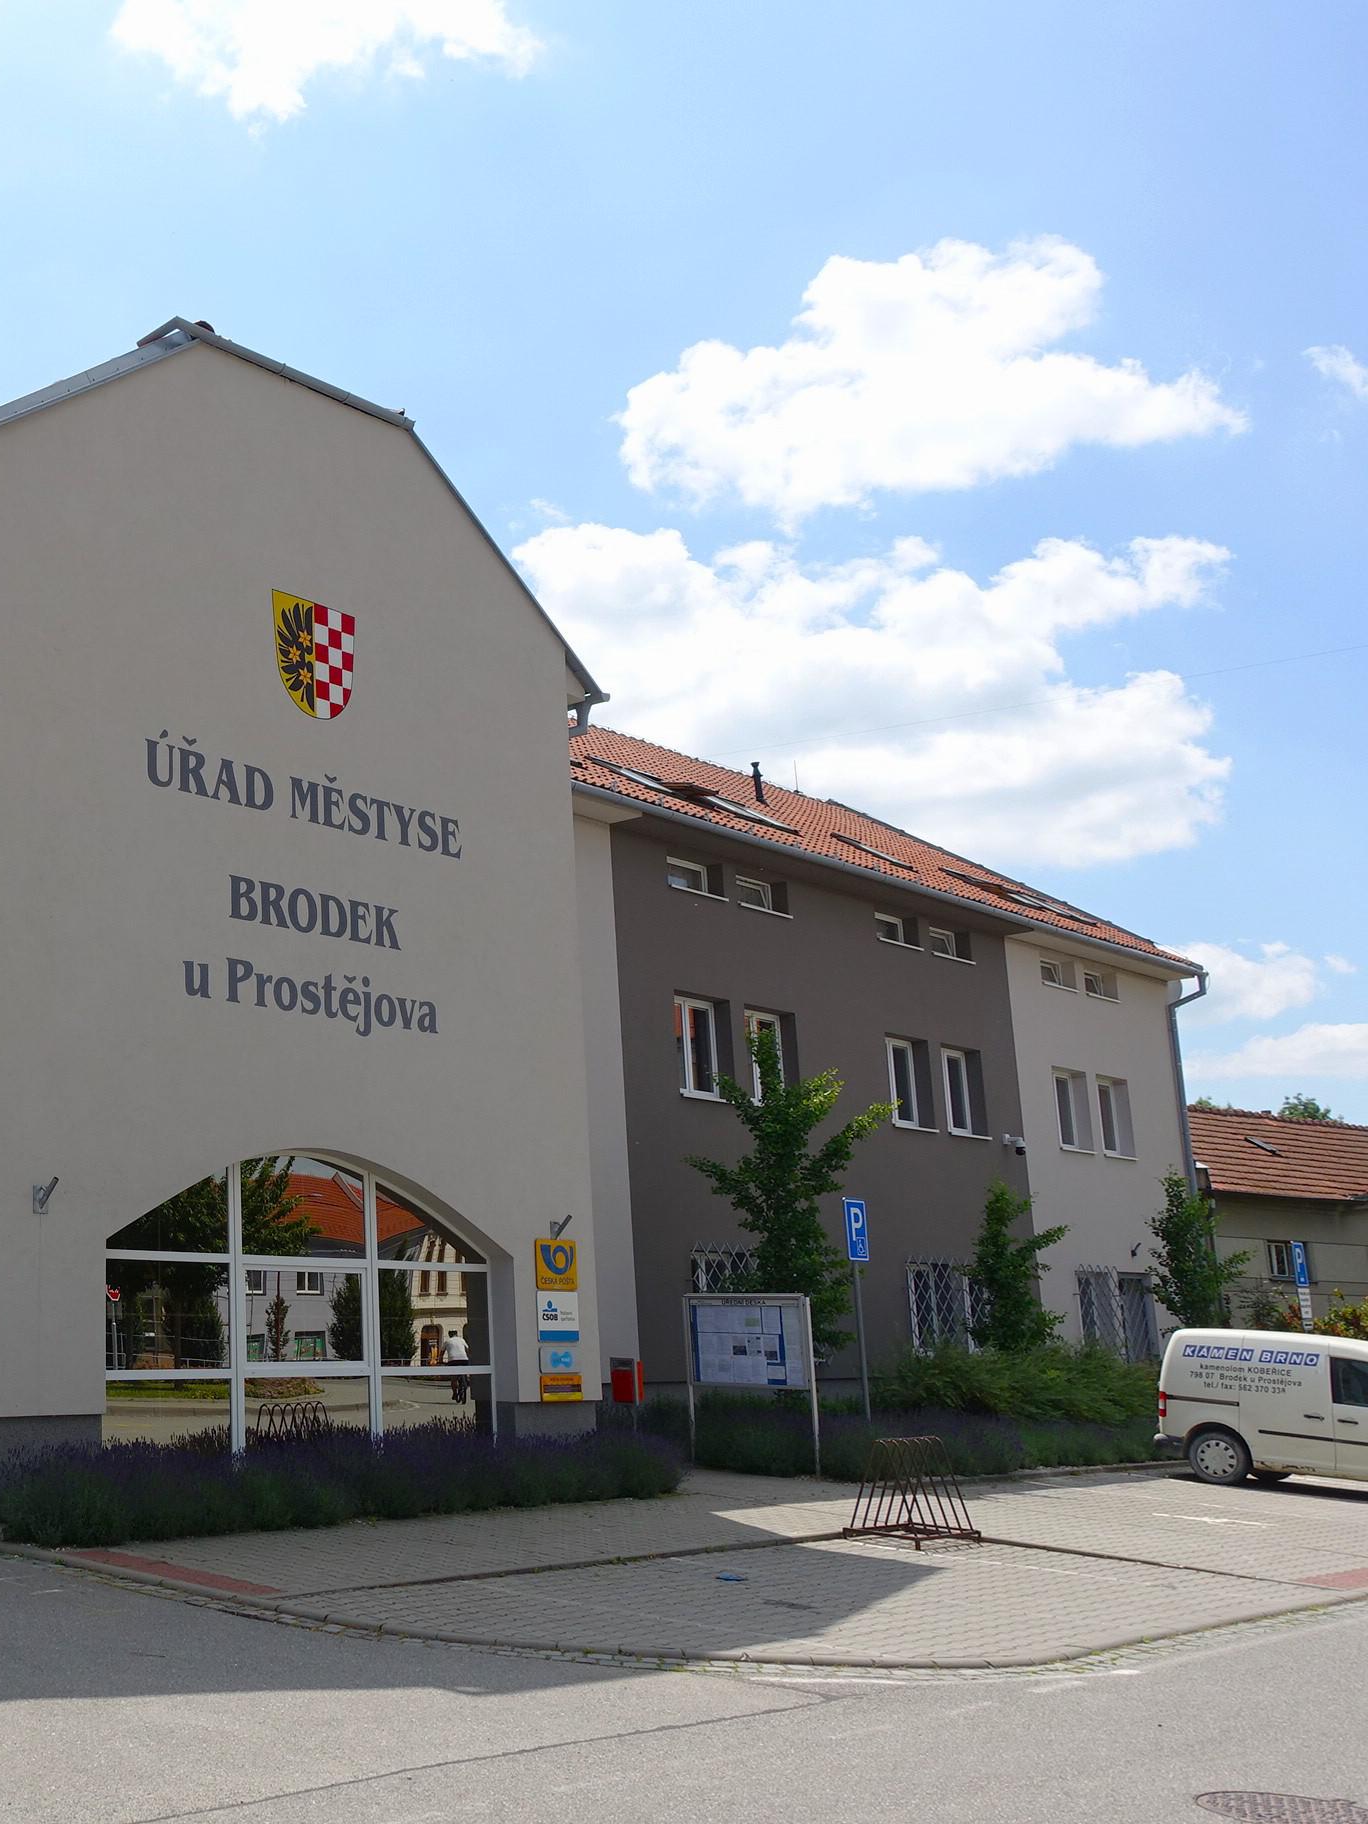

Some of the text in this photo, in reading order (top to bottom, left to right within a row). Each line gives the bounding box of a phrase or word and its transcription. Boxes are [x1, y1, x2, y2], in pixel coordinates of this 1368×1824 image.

[145, 729, 462, 859] ÚŘAD MĚSTYSE
[229, 874, 402, 951] BRODEK
[183, 957, 439, 1037] u Prostějova
[850, 1207, 863, 1241] P
[1295, 1247, 1303, 1273] P
[1184, 1345, 1319, 1366] KAMEN BRNO
[1200, 1363, 1245, 1374] kamenolom
[1219, 1373, 1248, 1383] Brodek
